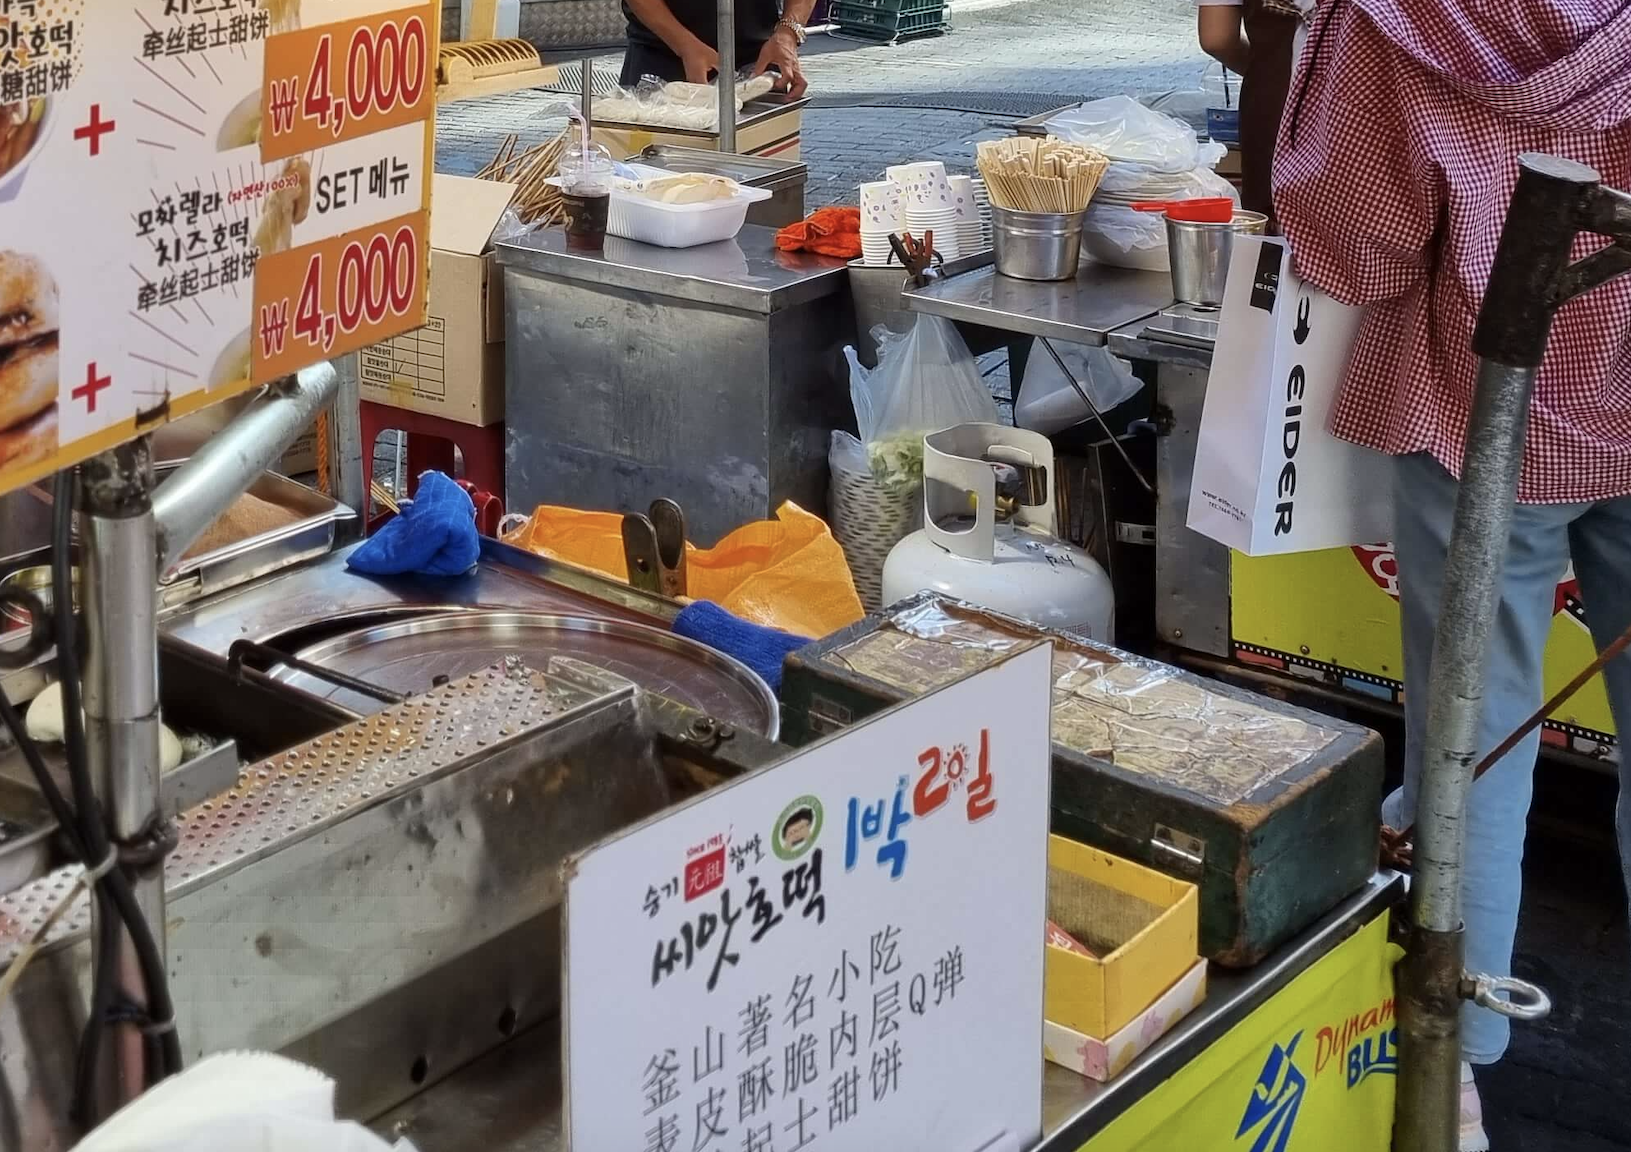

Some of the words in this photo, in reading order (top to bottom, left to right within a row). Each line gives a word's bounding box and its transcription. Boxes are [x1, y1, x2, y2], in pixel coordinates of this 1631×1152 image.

[316, 167, 364, 214] SET
[369, 156, 410, 199] 메뉴
[155, 217, 250, 267] 치즈호떡
[1274, 364, 1305, 537] EIDER
[643, 876, 679, 918] 승기
[651, 848, 826, 993] 씨앗호떡
